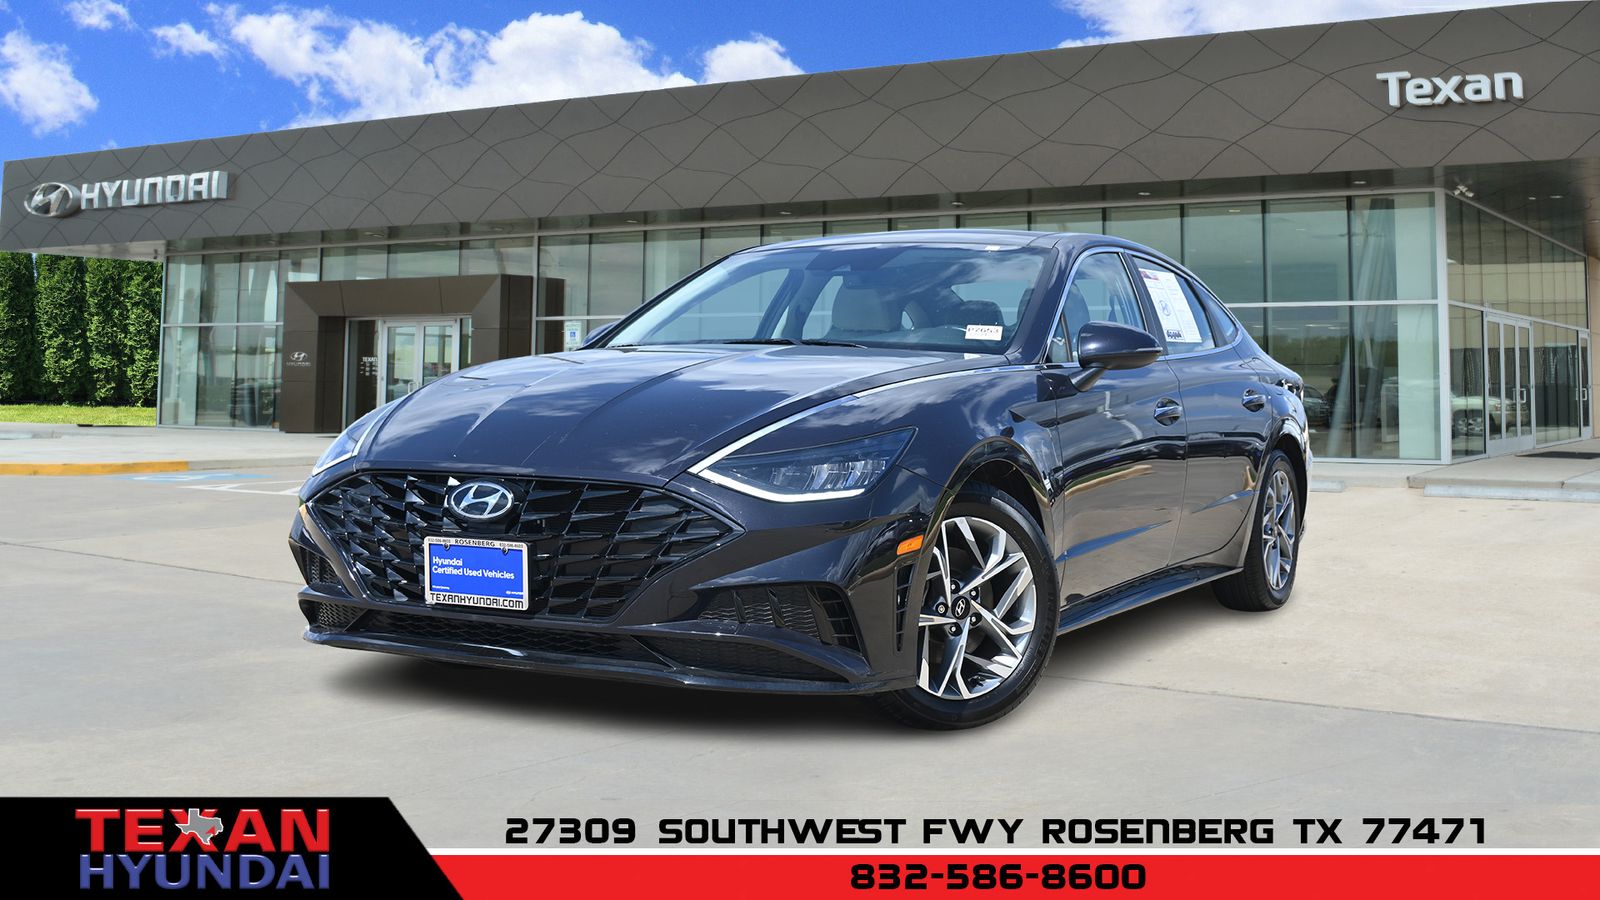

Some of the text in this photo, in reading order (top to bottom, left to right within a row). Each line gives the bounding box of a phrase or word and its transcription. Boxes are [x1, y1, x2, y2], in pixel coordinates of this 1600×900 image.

[1376, 70, 1524, 108] Texan
[81, 170, 227, 210] HYUNDAI
[454, 539, 496, 547] ROSENBERG
[432, 556, 463, 566] Hyundai
[432, 565, 515, 580] Certified Used Vehicles
[430, 592, 524, 609] TEXANHYUNDAI.COM
